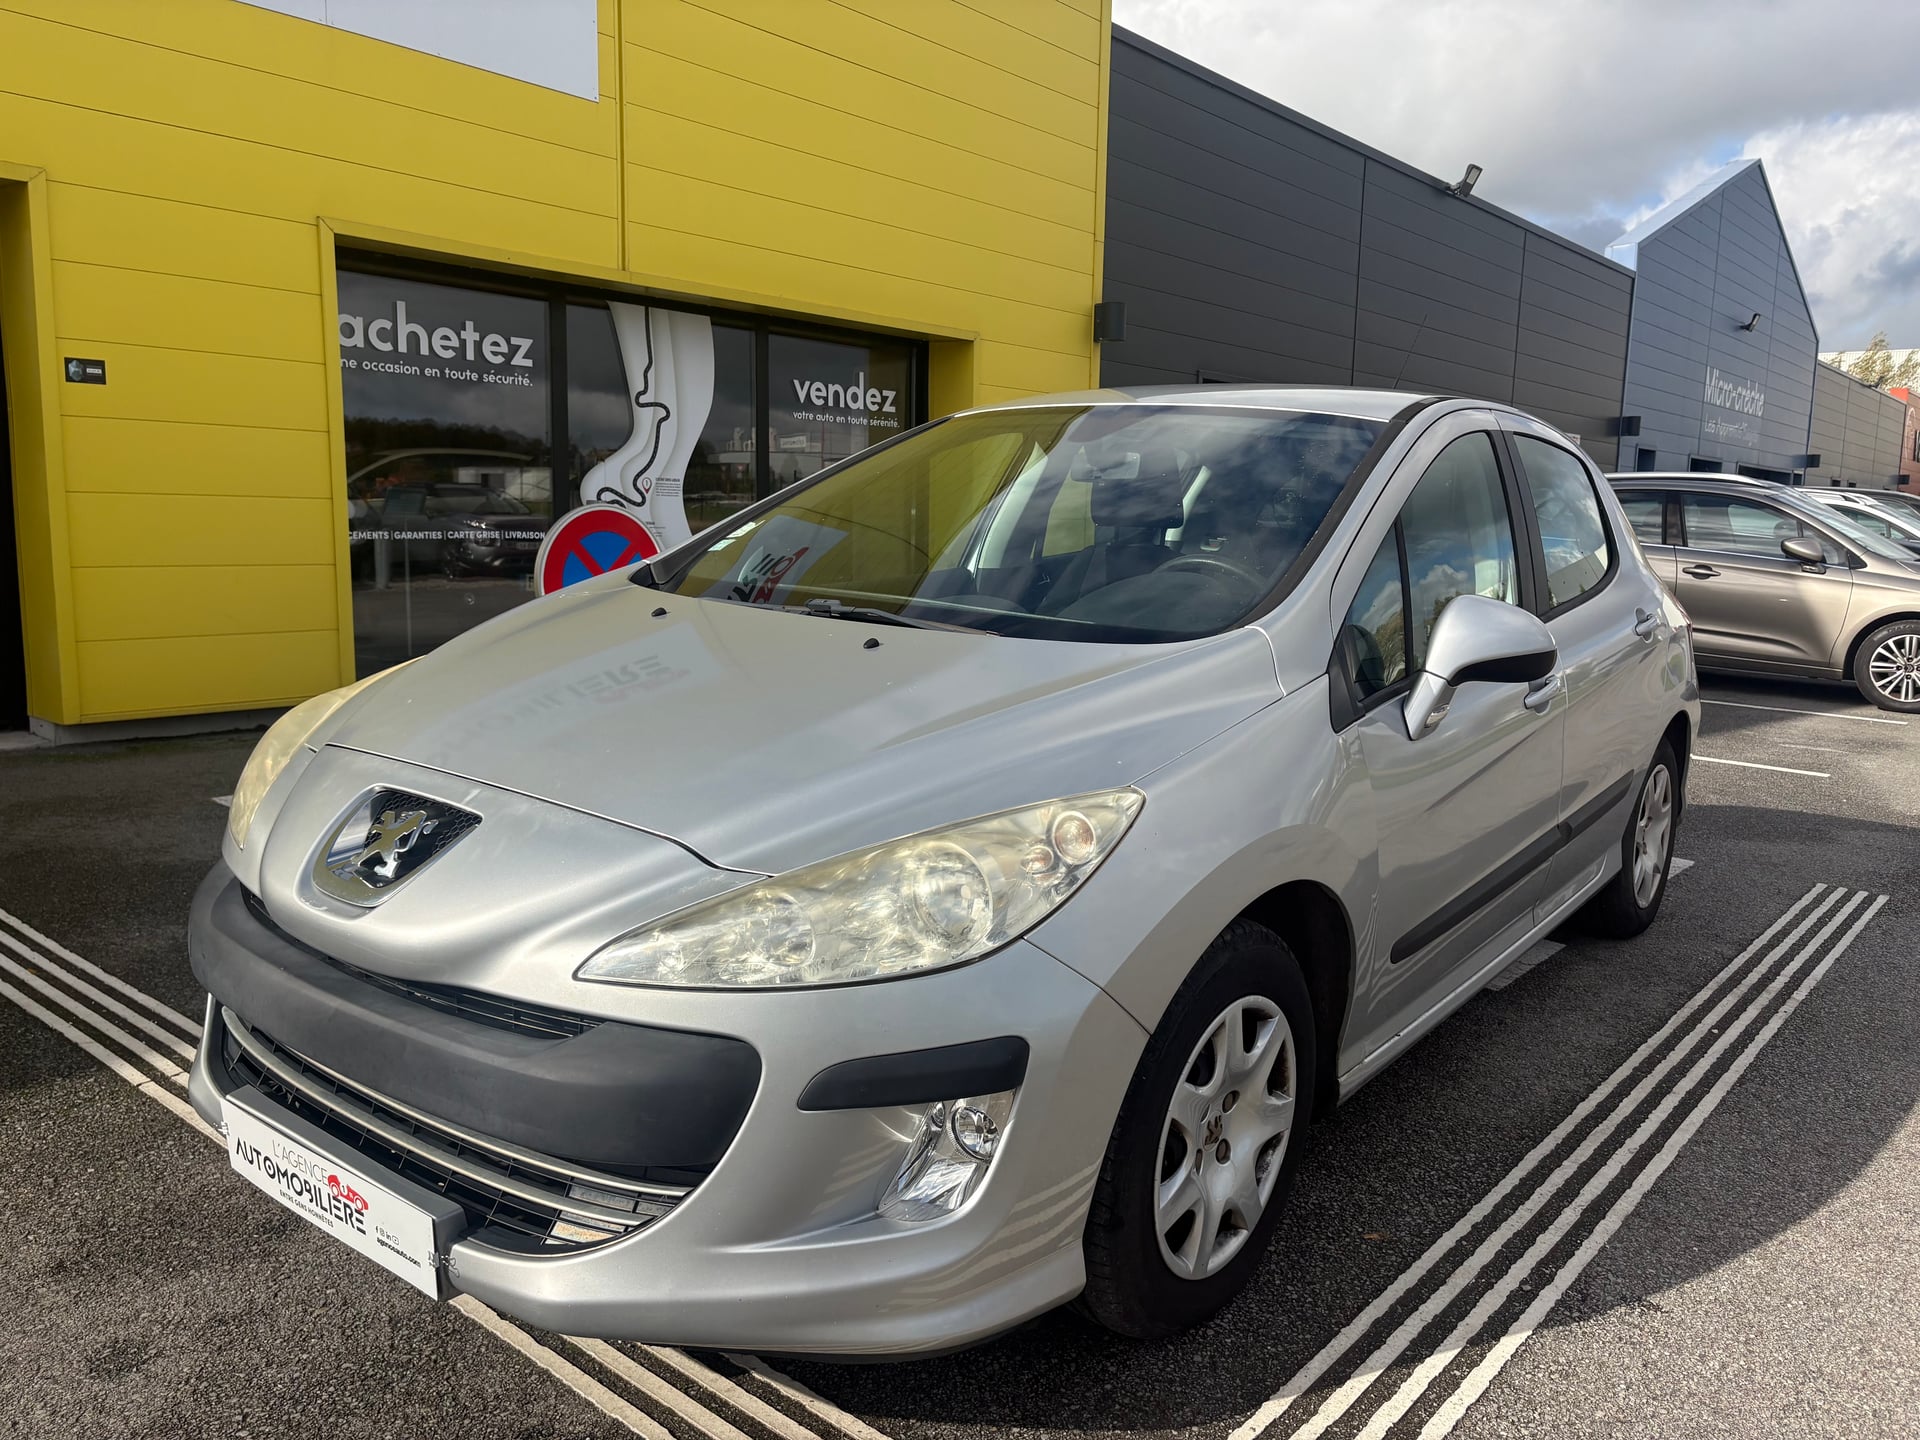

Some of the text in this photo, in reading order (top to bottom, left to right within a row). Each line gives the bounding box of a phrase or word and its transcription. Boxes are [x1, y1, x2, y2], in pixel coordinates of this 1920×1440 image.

[338, 300, 534, 368] achetez
[362, 360, 420, 376] occasion
[424, 368, 440, 379] en
[444, 367, 479, 382] toute
[482, 370, 534, 387] sécurité.
[792, 371, 897, 413] vendez
[1703, 365, 1765, 417] Micro-crèche
[792, 410, 900, 429] votre auto en toute sérénité.
[393, 531, 443, 540] GARANTIES
[447, 530, 475, 540] CARTE
[476, 530, 500, 540] GRISE
[505, 531, 546, 541] LIVRAISON
[272, 1138, 329, 1187] L'AGENCE
[279, 1188, 334, 1229] ENTRE GENS HONNÊTES
